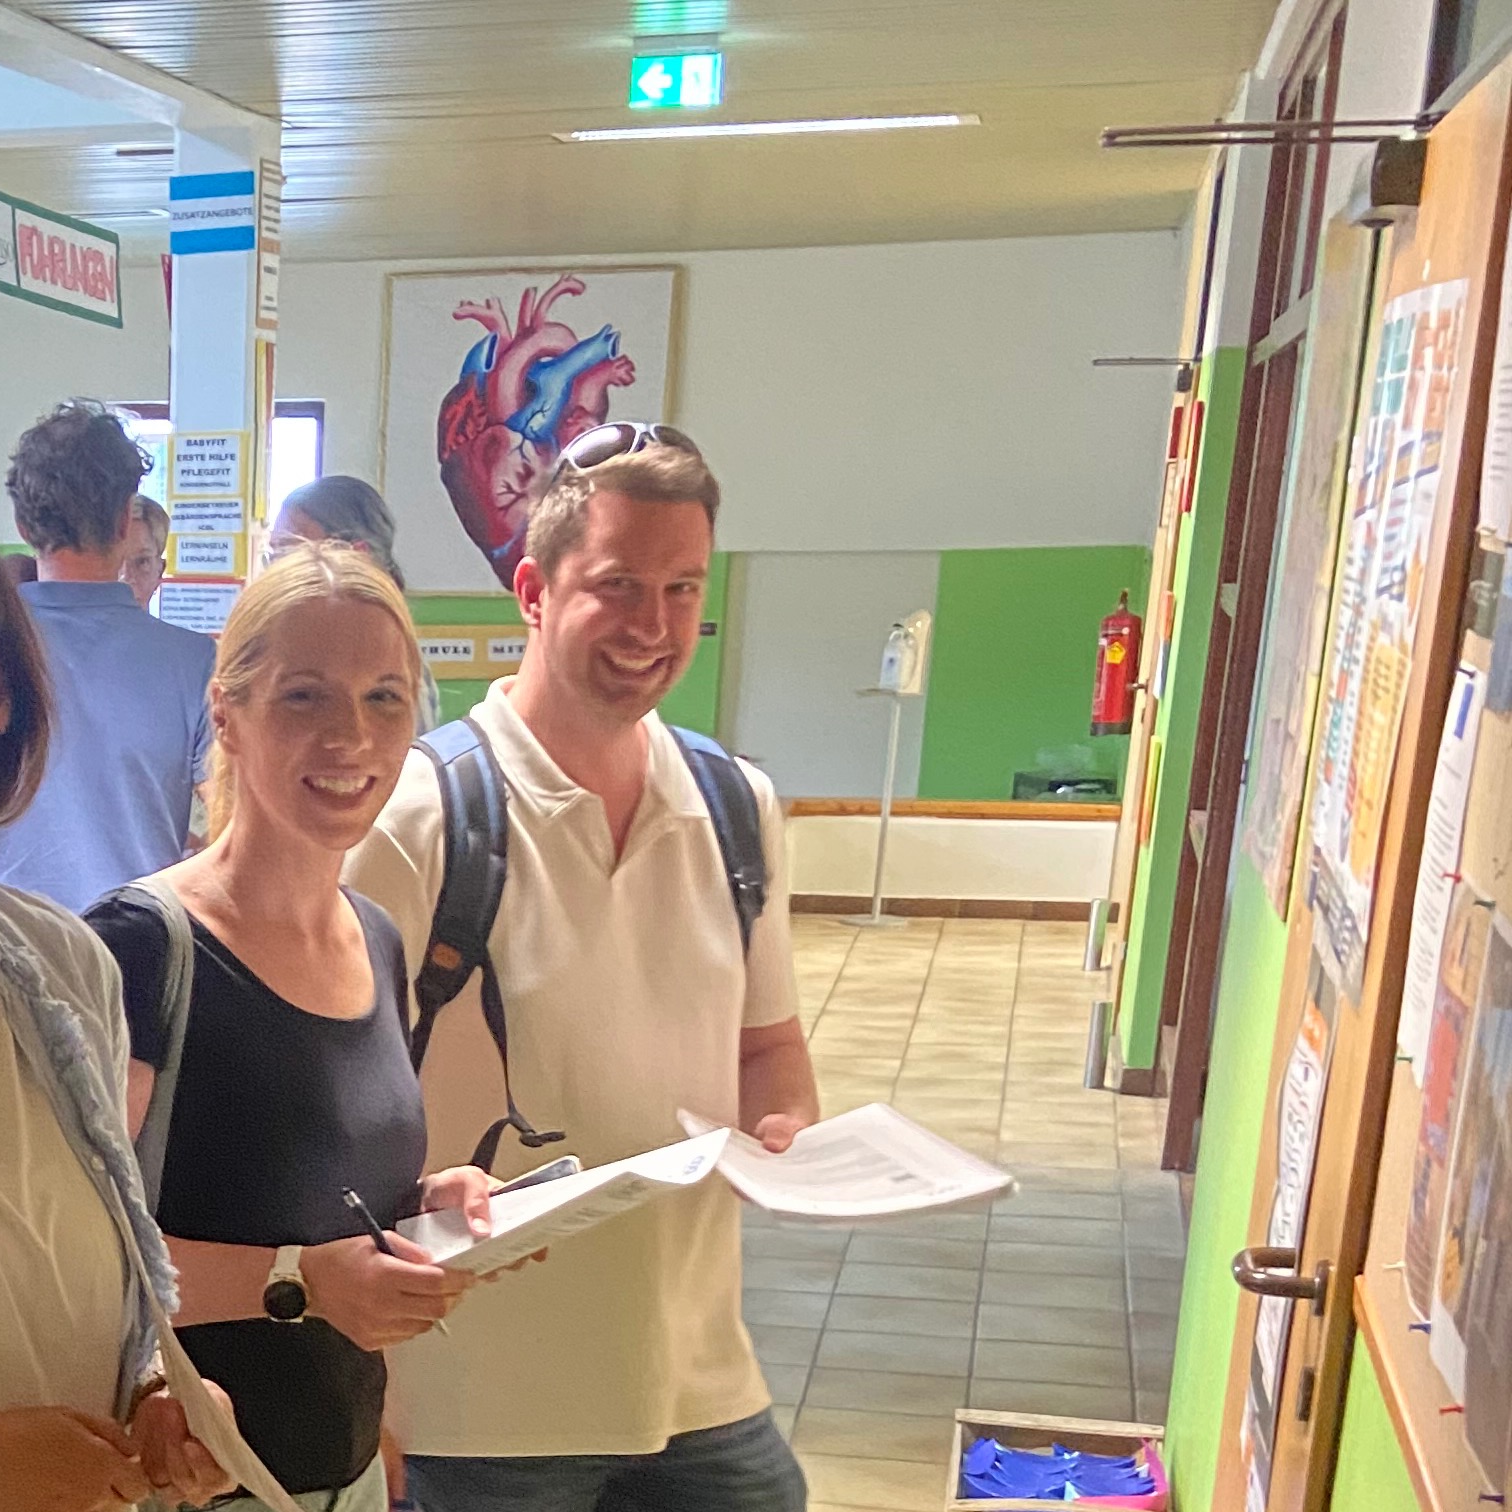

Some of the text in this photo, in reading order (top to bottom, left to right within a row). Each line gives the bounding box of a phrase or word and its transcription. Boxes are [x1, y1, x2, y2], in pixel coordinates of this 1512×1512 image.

[172, 207, 253, 220] ZUSATZANGEBOTE
[186, 439, 227, 447] BABYFIT
[177, 453, 236, 462] ERSTE HILFE
[181, 468, 231, 476] PFLEGEFIT
